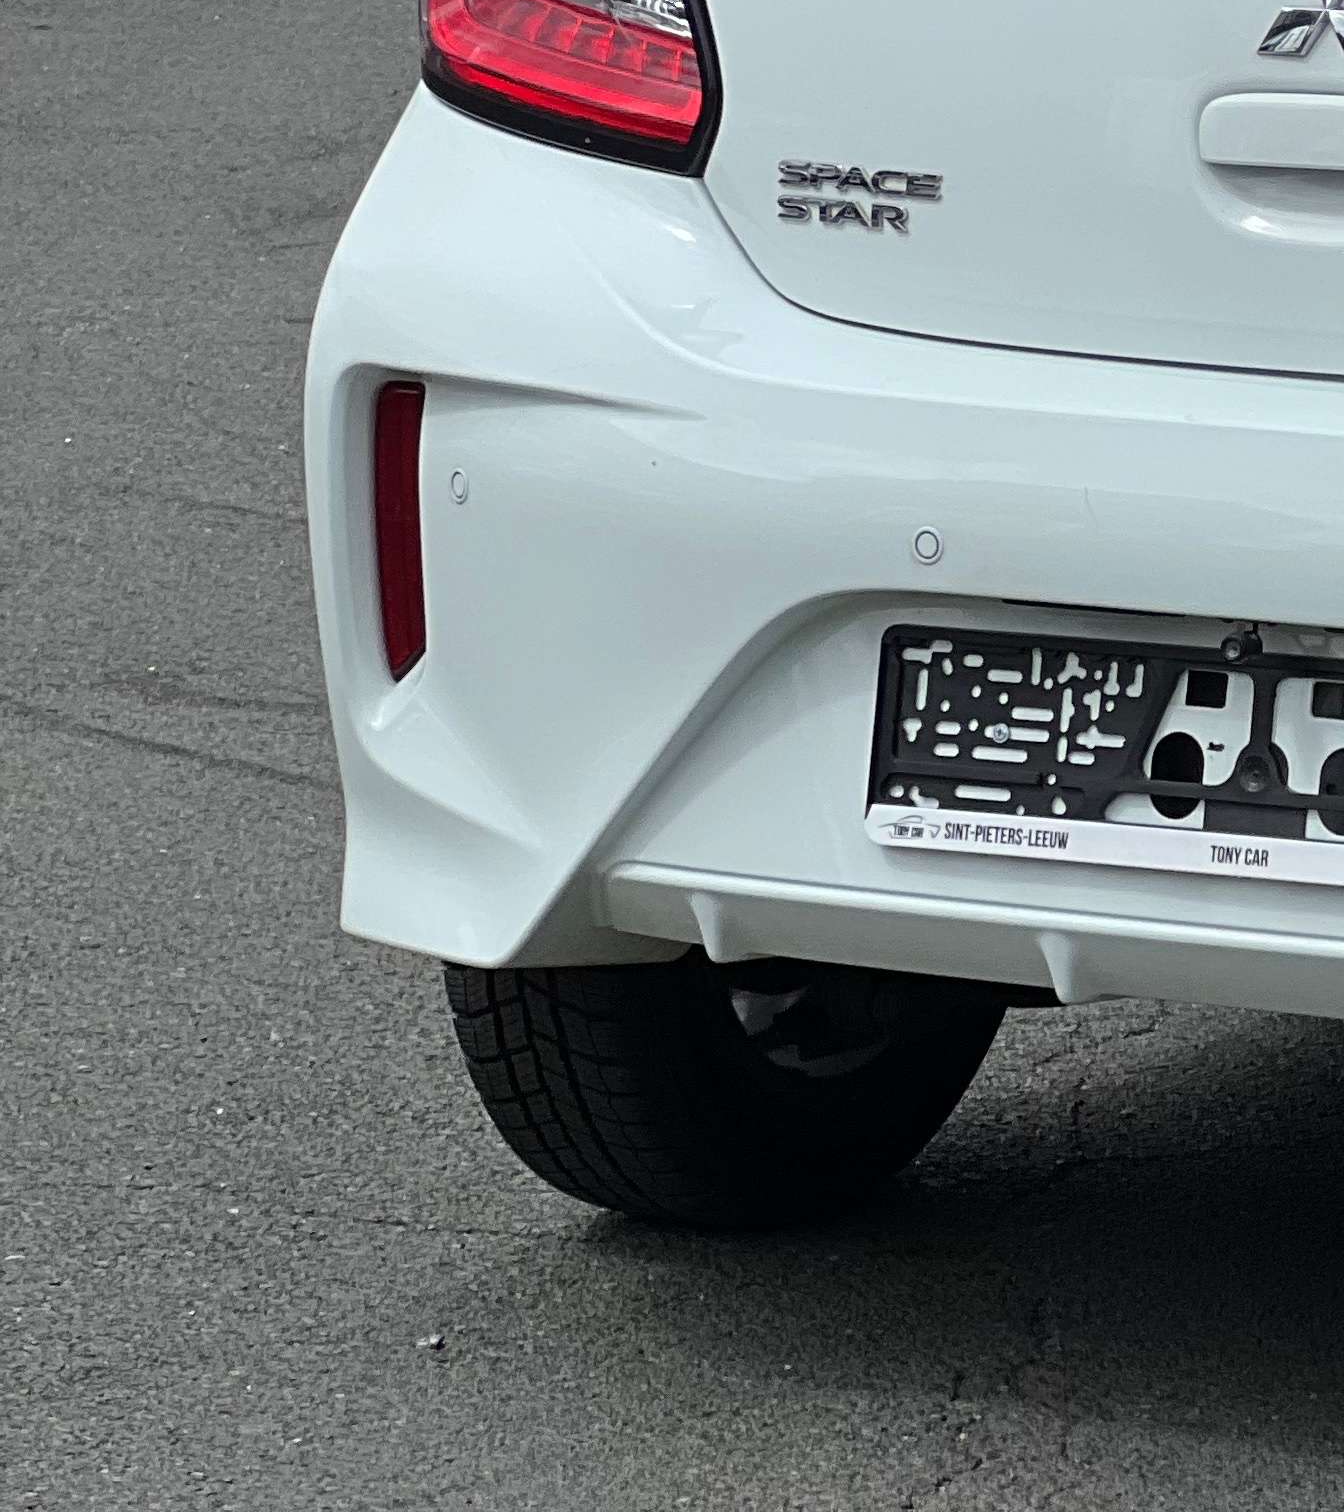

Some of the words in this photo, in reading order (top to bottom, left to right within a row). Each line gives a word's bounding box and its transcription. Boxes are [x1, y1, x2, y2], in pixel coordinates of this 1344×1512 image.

[777, 160, 944, 202] SPACE
[777, 194, 910, 235] STAR
[944, 821, 1070, 850] SINT-PIETERS-LEEUW
[1210, 845, 1242, 865] TONY
[1244, 848, 1270, 867] CAR
